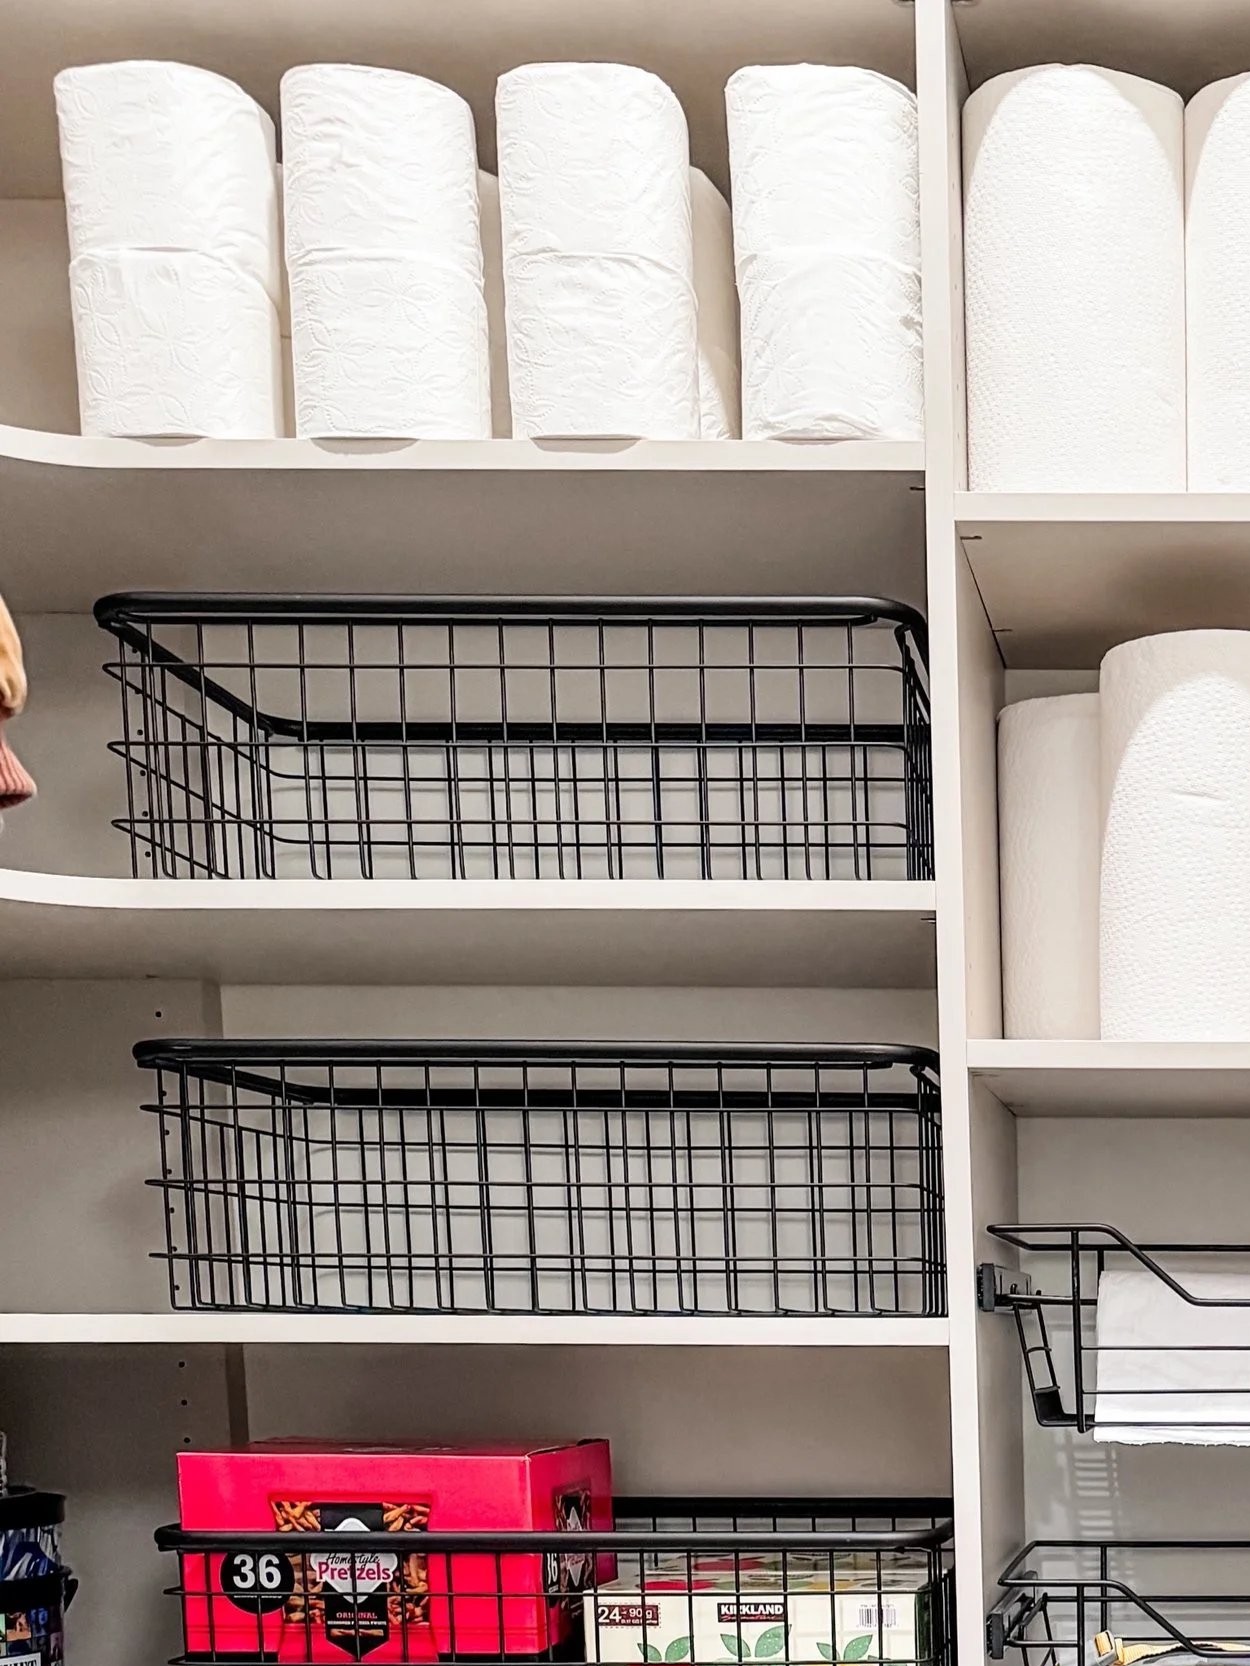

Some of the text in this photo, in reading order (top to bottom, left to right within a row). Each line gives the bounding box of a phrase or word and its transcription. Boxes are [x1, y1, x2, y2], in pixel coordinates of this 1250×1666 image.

[233, 1554, 281, 1589] 36
[318, 1561, 391, 1580] Prezels
[598, 1607, 622, 1623] 24
